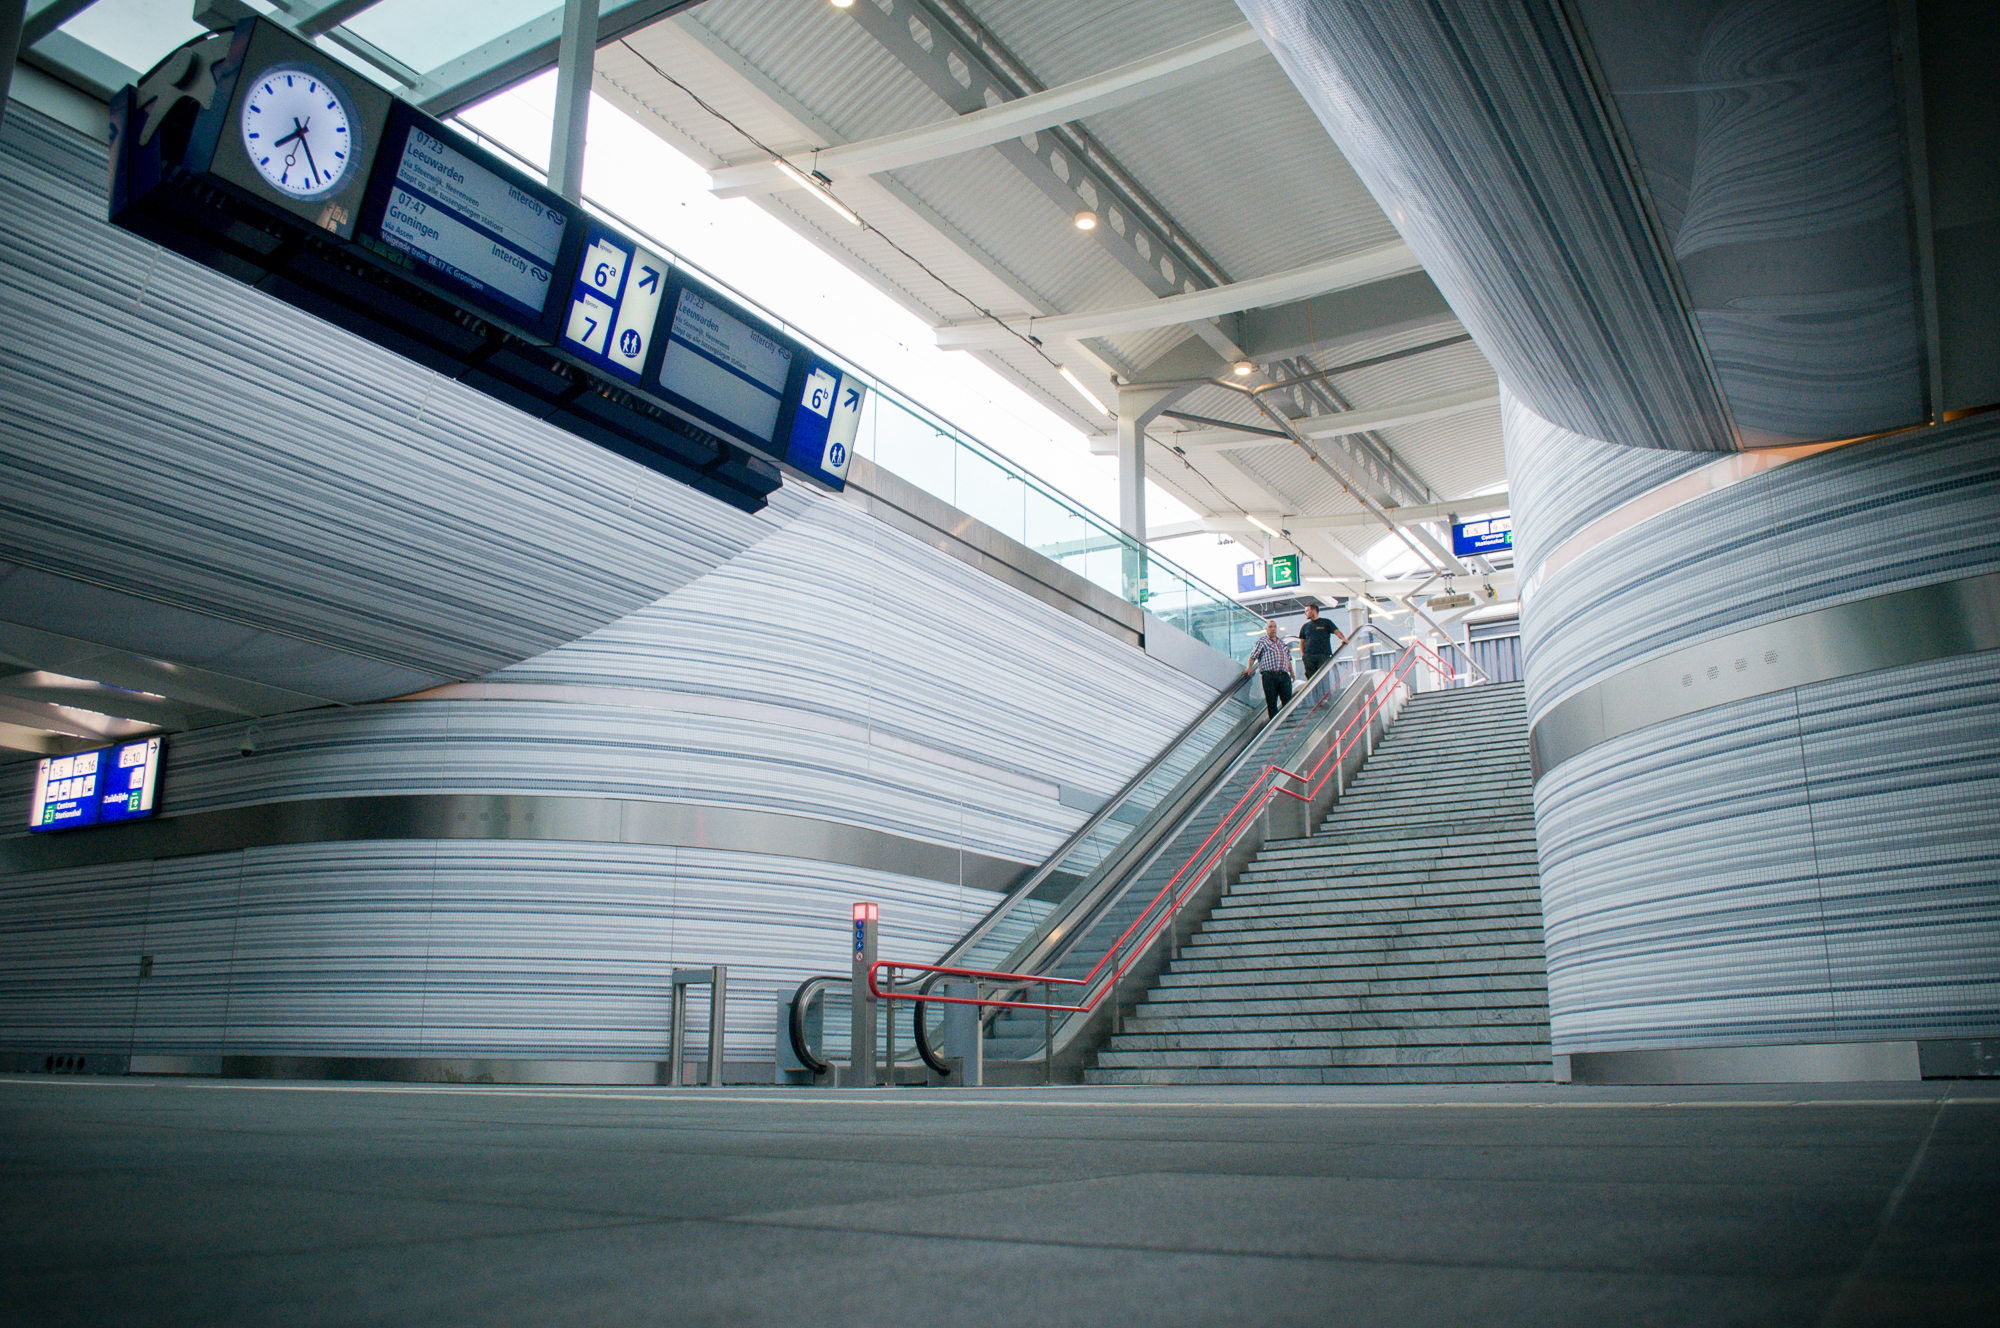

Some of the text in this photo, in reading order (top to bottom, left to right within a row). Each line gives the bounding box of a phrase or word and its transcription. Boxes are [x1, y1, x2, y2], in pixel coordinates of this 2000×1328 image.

[416, 131, 444, 155] 07:23
[407, 142, 465, 184] Leeuwarden
[402, 160, 412, 169] via
[445, 182, 480, 208] Heerenveen
[398, 192, 427, 215] 07:47
[400, 168, 504, 233] Stopt op alle tussengelegen stations
[508, 185, 544, 217] Intercity
[384, 221, 414, 241] via Assen
[389, 204, 440, 241] Groningen
[381, 230, 411, 253] Volgende
[446, 265, 454, 274] IC
[453, 269, 484, 291] Groningen
[491, 244, 528, 274] Intercity
[600, 243, 613, 255] spoor
[585, 299, 599, 310] spoor
[684, 291, 705, 310] 07:23
[678, 301, 719, 333] Leeuwarden
[581, 316, 598, 343] 7
[750, 330, 777, 354] Intercity
[1481, 533, 1504, 541] Centrum
[56, 801, 77, 810] Centrum
[103, 792, 129, 804] Zuidzijde
